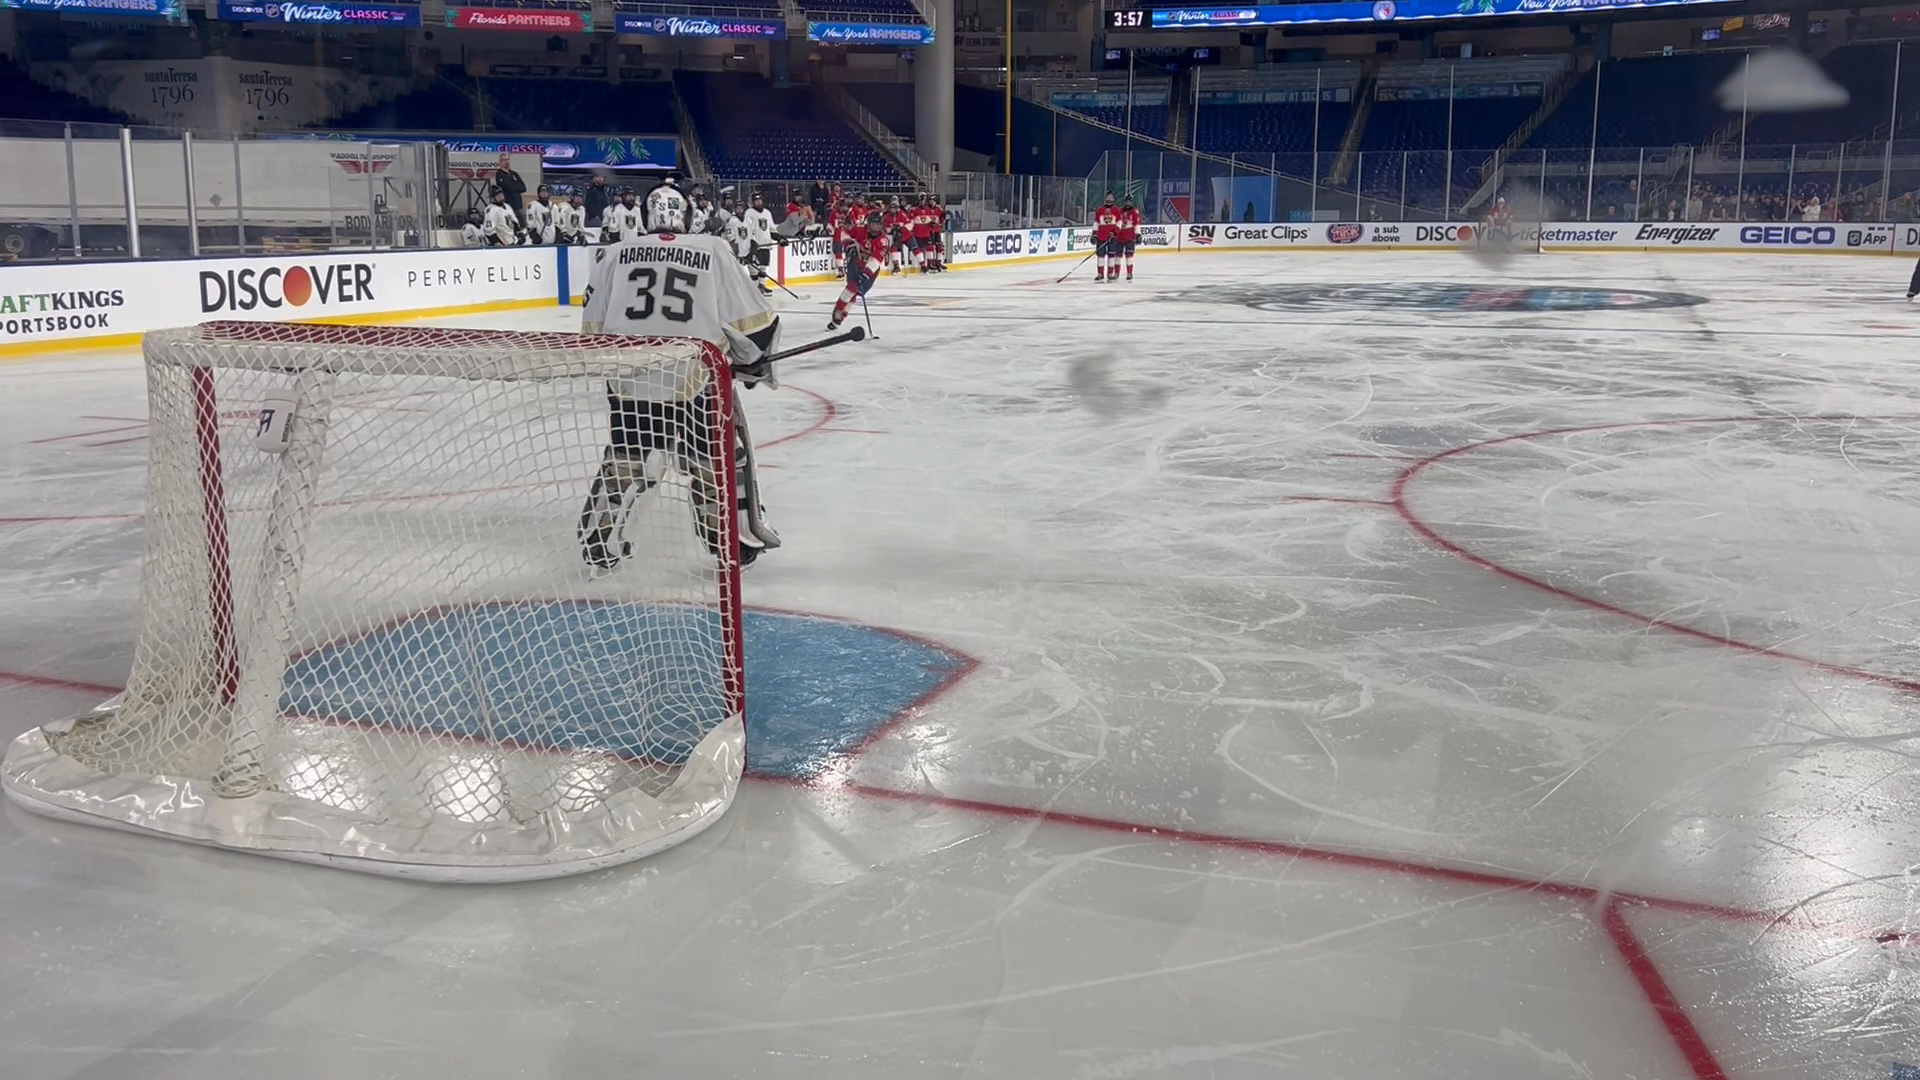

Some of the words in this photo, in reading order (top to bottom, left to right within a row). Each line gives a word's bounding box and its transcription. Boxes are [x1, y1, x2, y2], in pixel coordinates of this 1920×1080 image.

[87, 0, 158, 11] RANGERS
[232, 6, 264, 14] DISCOVER
[280, 2, 343, 22] Winter
[344, 9, 389, 20] CLASSIC
[469, 12, 507, 24] Florida
[508, 15, 571, 26] PANTHERS
[1113, 11, 1144, 27] 3:57
[1177, 10, 1210, 22] Winter
[624, 20, 652, 28] DISCOVER
[667, 17, 721, 36] Winter
[722, 24, 762, 34] CLASSIC
[822, 27, 846, 38] New
[845, 28, 869, 41] York
[869, 28, 922, 40] RANGERS
[497, 144, 547, 154] CLASSIC
[1188, 225, 1216, 238] SN
[1225, 226, 1269, 240] Great
[1276, 225, 1308, 243] Clips
[1382, 225, 1400, 234] sub
[1416, 225, 1498, 242] DISCOV
[1519, 227, 1618, 242] ticketmaster
[1635, 224, 1720, 245] Energizer
[1740, 226, 1836, 245] GEICO
[986, 233, 1022, 256] GEICO
[1371, 233, 1401, 243] above
[619, 247, 711, 271] HARRICHARAN
[799, 259, 829, 273] CRUISE
[408, 267, 476, 288] PERRY
[487, 264, 542, 282] ELLIS
[199, 263, 375, 313] DISCOVER
[625, 267, 698, 322] 35
